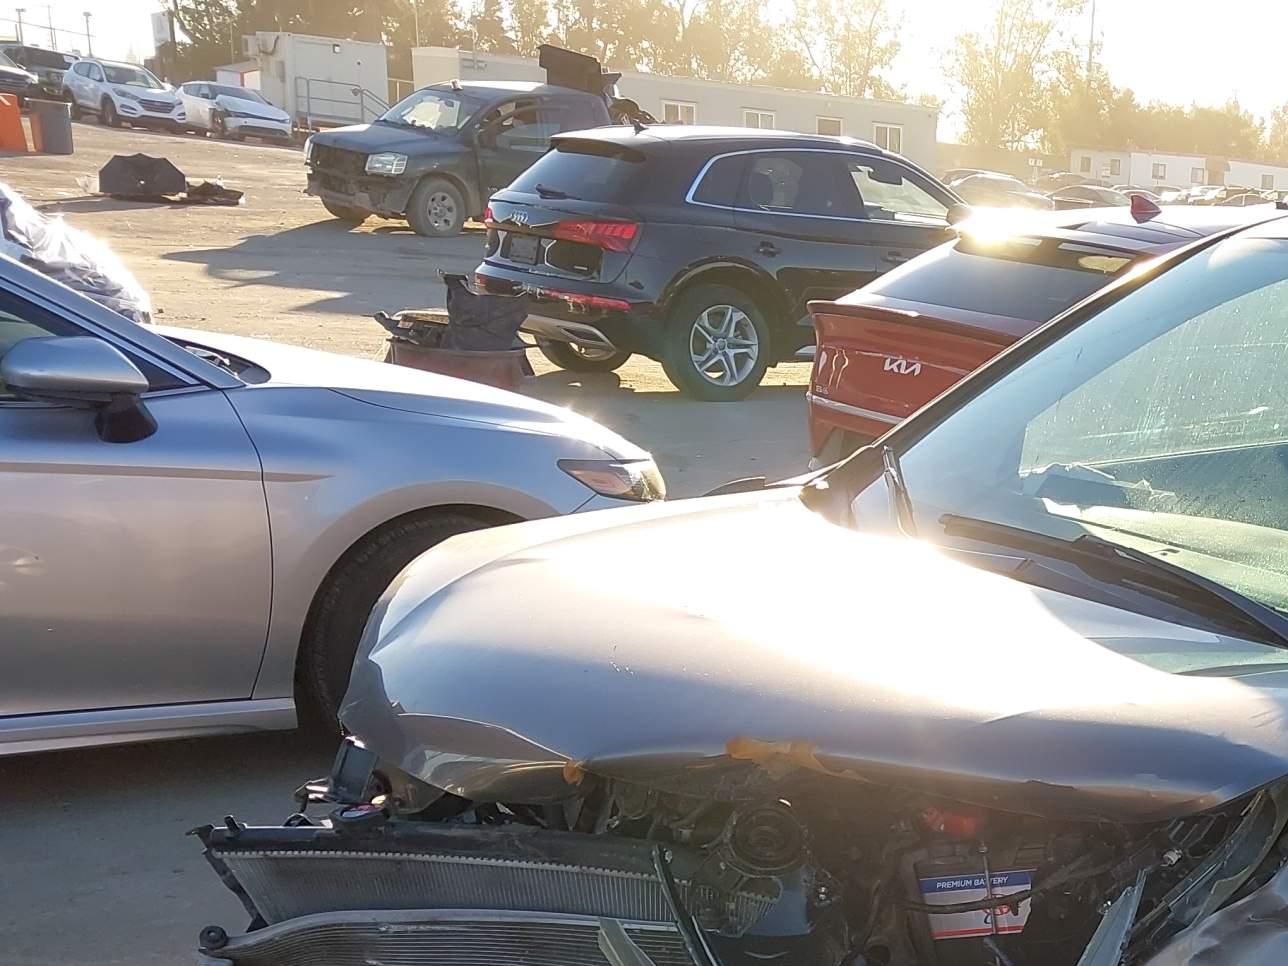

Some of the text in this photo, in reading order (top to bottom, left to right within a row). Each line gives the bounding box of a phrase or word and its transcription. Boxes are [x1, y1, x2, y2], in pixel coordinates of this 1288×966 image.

[884, 357, 921, 376] KIA
[936, 876, 1009, 889] PREMIUM BATERY
